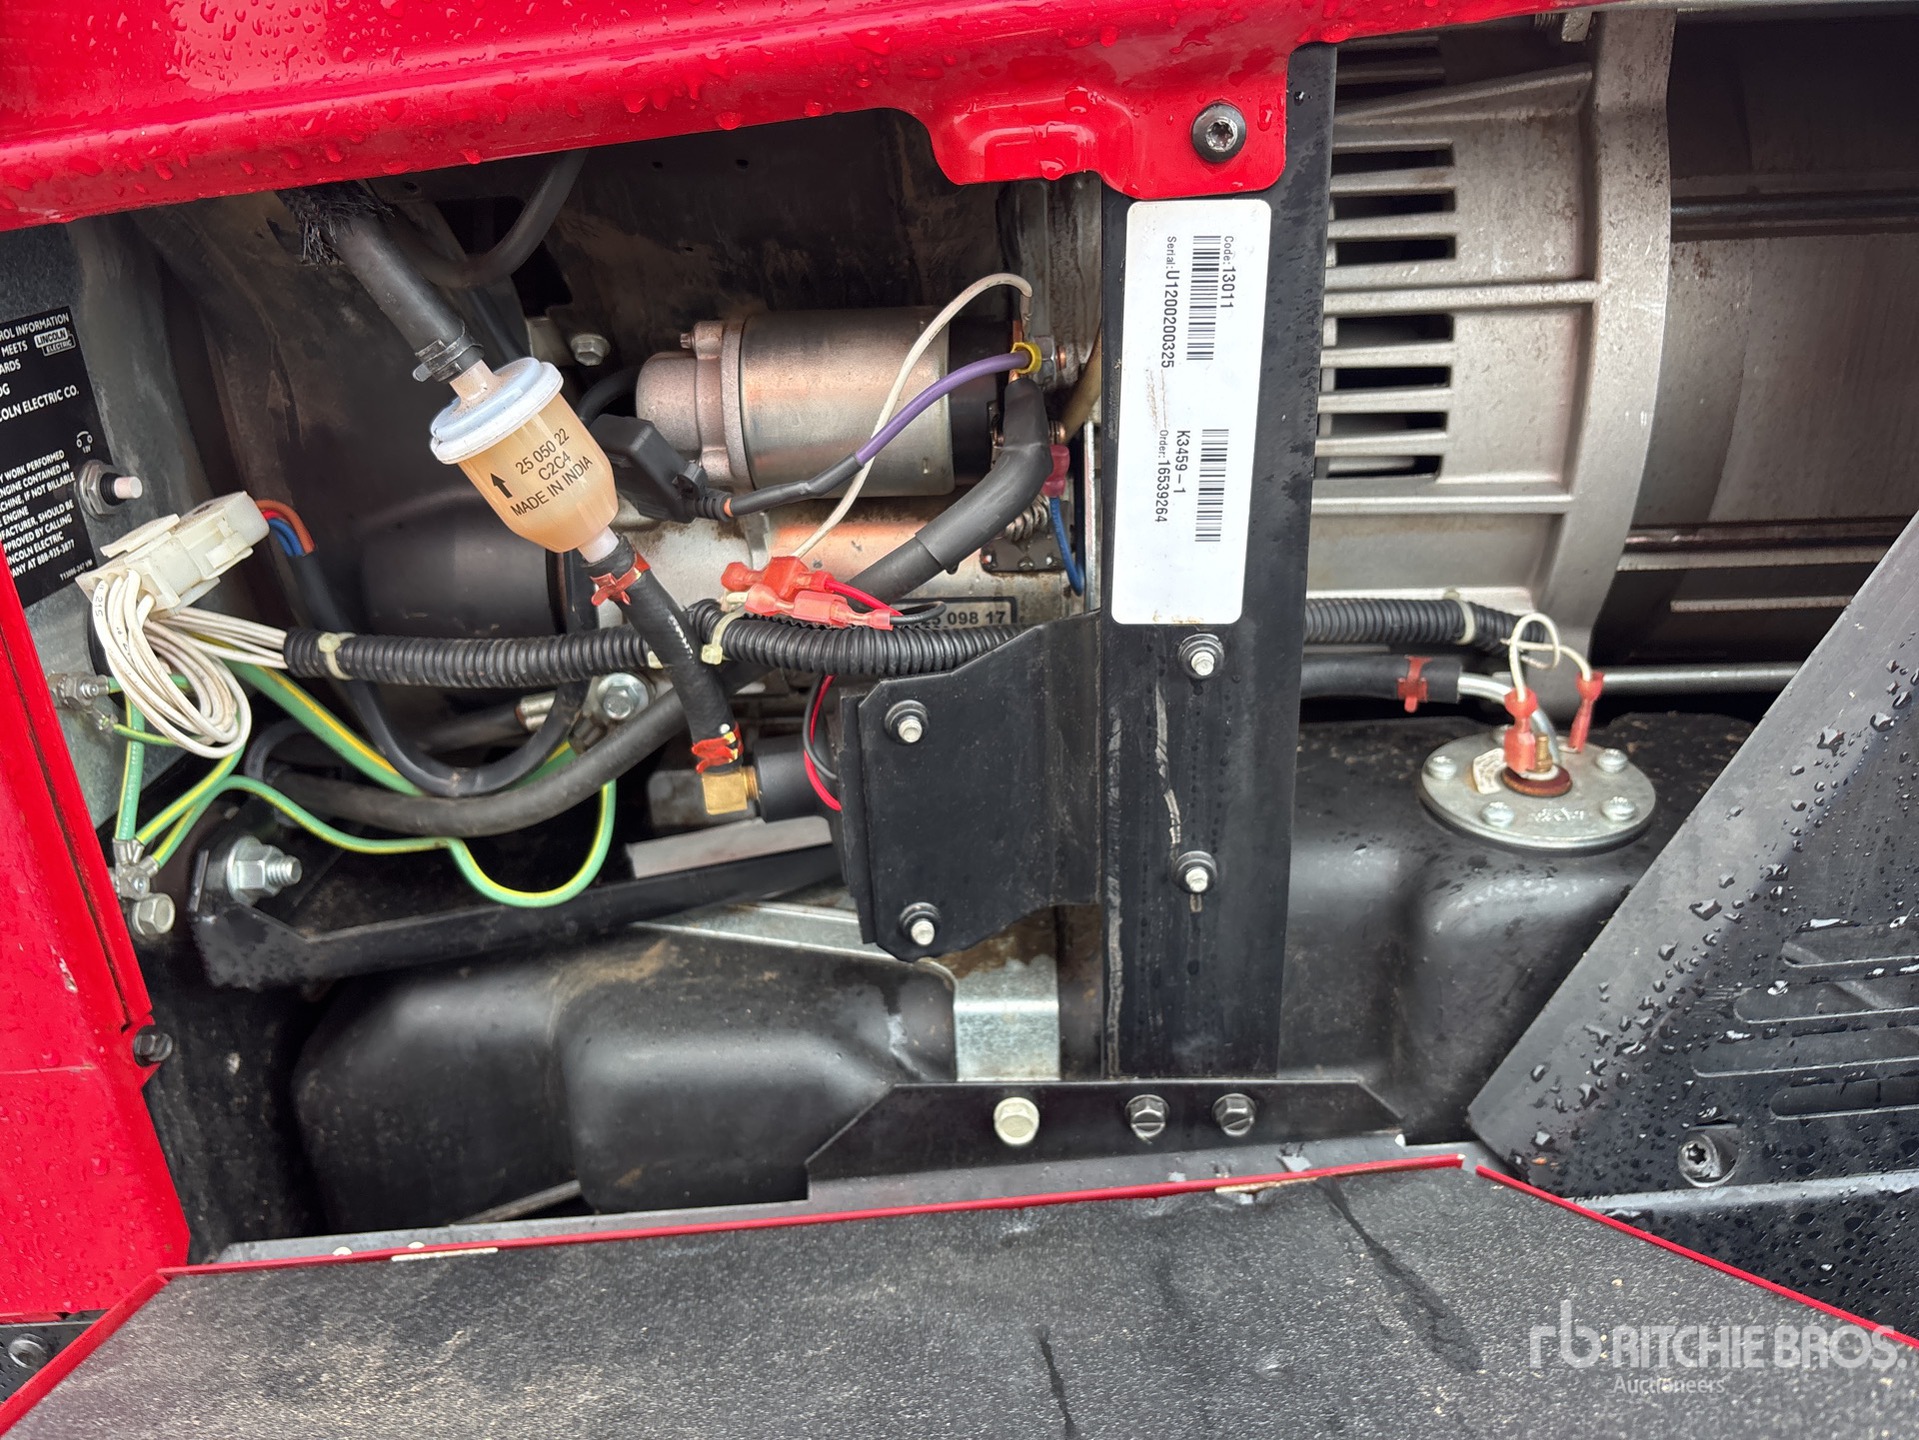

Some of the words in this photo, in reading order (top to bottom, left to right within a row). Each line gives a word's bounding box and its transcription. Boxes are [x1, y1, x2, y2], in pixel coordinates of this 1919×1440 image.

[16, 313, 69, 336] INFORMATION
[36, 328, 67, 345] LINCOLN
[1, 340, 28, 357] MEETS
[46, 339, 72, 353] ELECTRIC
[22, 389, 63, 414] ELECTRIC
[64, 385, 80, 398] CO.
[516, 456, 534, 475] 25
[532, 440, 556, 463] 050
[554, 428, 570, 446] 22
[4, 465, 26, 481] WORK
[26, 450, 65, 472] PERFORMED
[22, 464, 62, 488] CONTAINED
[61, 461, 70, 472] IN
[538, 450, 572, 480] C2C4
[24, 491, 30, 502] IF
[31, 484, 46, 498] NOT
[46, 472, 76, 492] BILLABLE
[510, 490, 550, 516] MADE
[546, 480, 564, 497] IN
[562, 456, 593, 486] INDIA
[2, 506, 30, 526] ENGINE
[38, 504, 65, 524] SHOULD
[64, 499, 74, 511] BE
[34, 526, 44, 538] BY
[45, 514, 72, 534] CALLING
[34, 531, 64, 553] ELECTRIC
[28, 558, 36, 571] AT
[947, 612, 979, 625] 098
[986, 611, 1006, 624] 17
